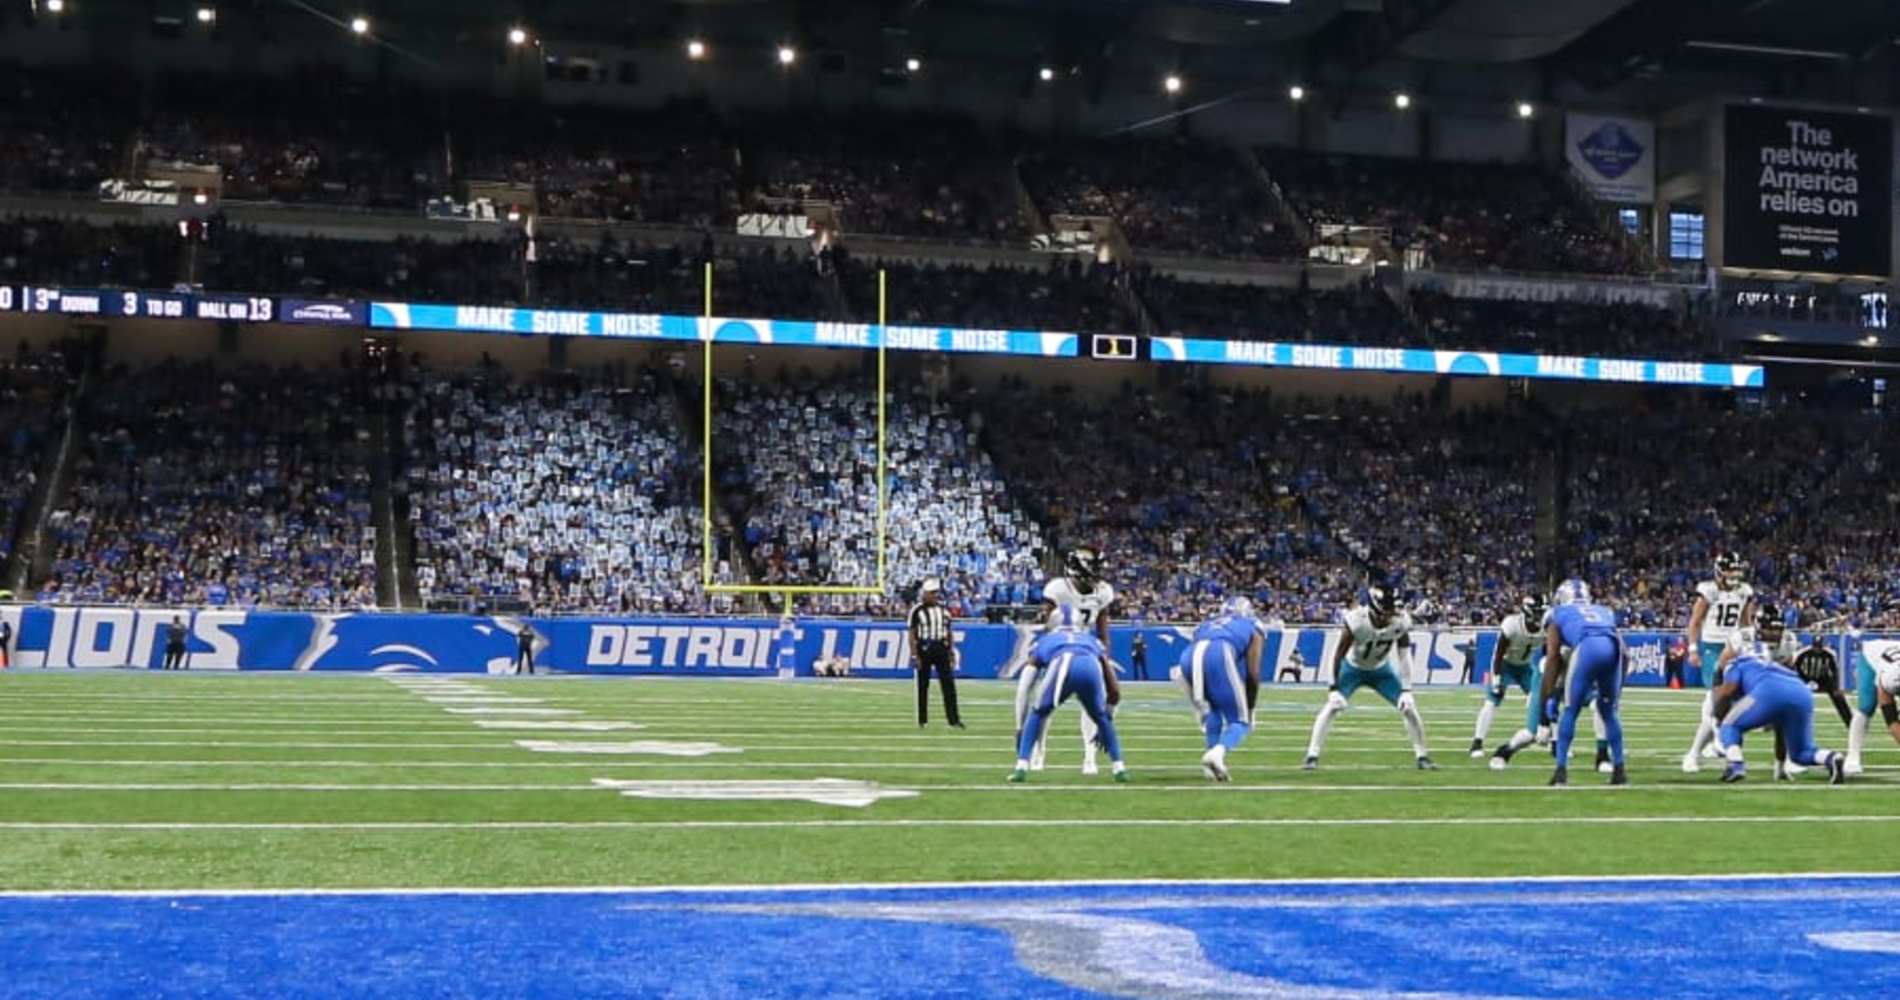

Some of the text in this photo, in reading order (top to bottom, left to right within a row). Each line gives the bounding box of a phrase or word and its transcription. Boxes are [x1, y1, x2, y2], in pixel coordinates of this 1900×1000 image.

[1786, 120, 1832, 146] The
[1760, 145, 1859, 171] network
[1759, 164, 1859, 194] America
[1760, 190, 1859, 218] relies on
[123, 292, 137, 316] 3
[249, 297, 272, 321] 13
[457, 306, 662, 338] MAKE SOME NOISE
[815, 322, 1009, 352] MAKE SOME NOISE
[1226, 340, 1404, 371] MAKE SOME NOISE
[1537, 355, 1704, 385] MAKE SOME NOISE
[1716, 603, 1740, 627] 16
